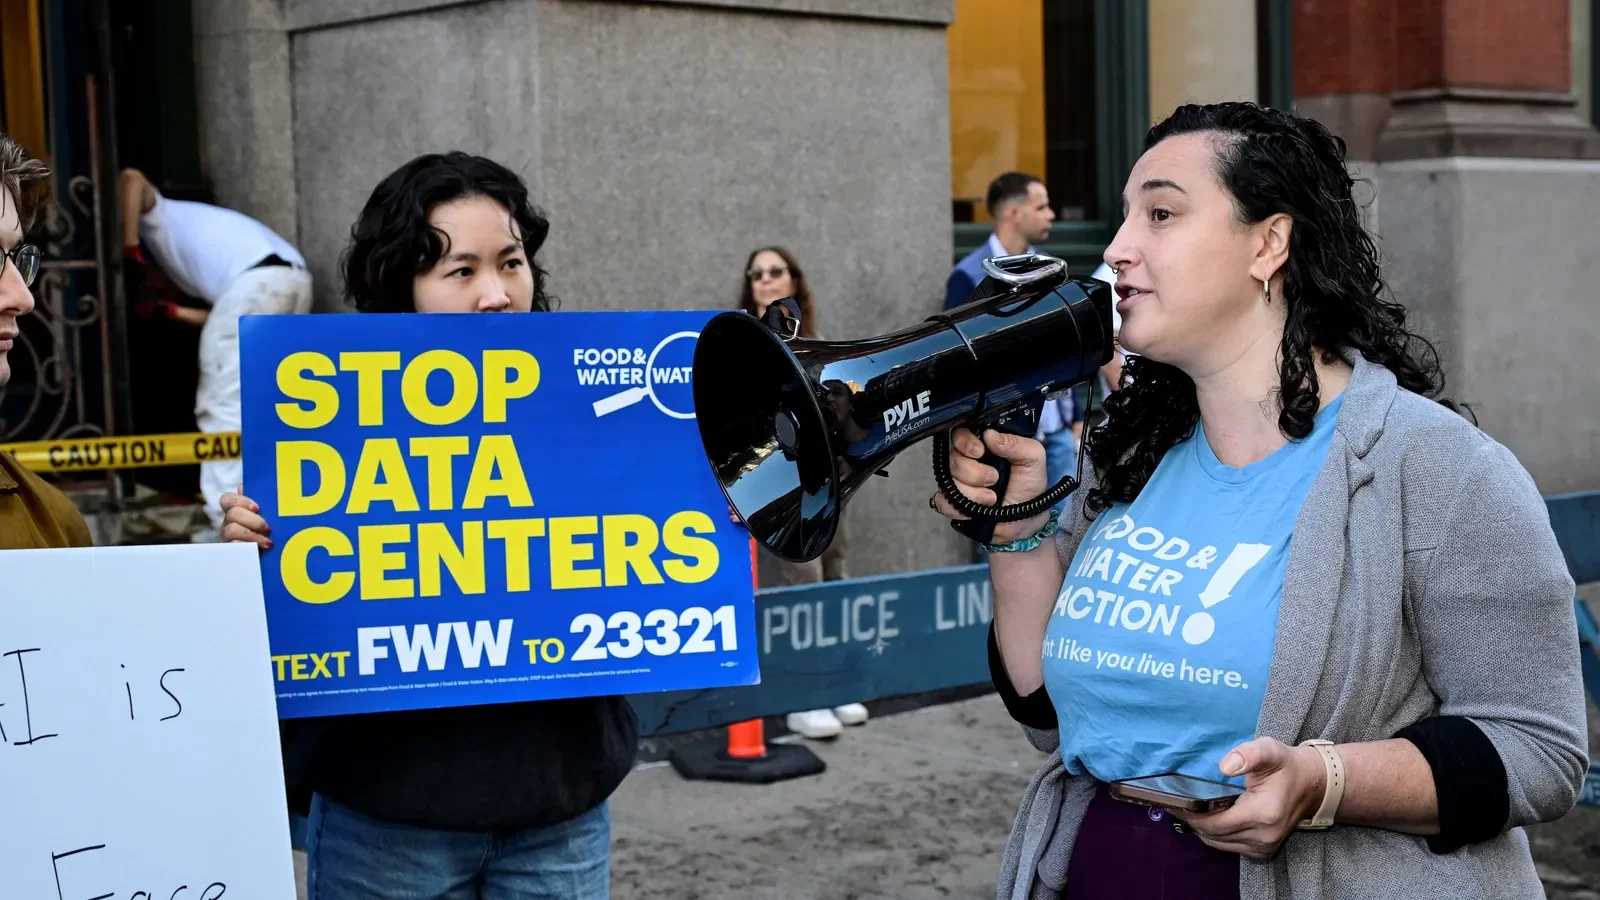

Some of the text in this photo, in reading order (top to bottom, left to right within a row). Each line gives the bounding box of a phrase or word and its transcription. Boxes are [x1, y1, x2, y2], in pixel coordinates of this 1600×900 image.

[275, 349, 540, 429] STOP
[576, 367, 693, 385] WATER WAT
[883, 391, 930, 433] PYLE
[49, 440, 165, 467] CAUTION
[275, 434, 534, 517] DATA
[279, 510, 720, 604] CENTERS
[272, 605, 739, 681] TEXT FWW TO 23321
[763, 580, 990, 654] POLICE LIN
[1052, 585, 1181, 637] ACTION
[0, 648, 185, 745] I is
[1057, 637, 1092, 663] like
[1096, 649, 1134, 671] you
[1136, 654, 1176, 679] live
[1179, 658, 1249, 690] here.
